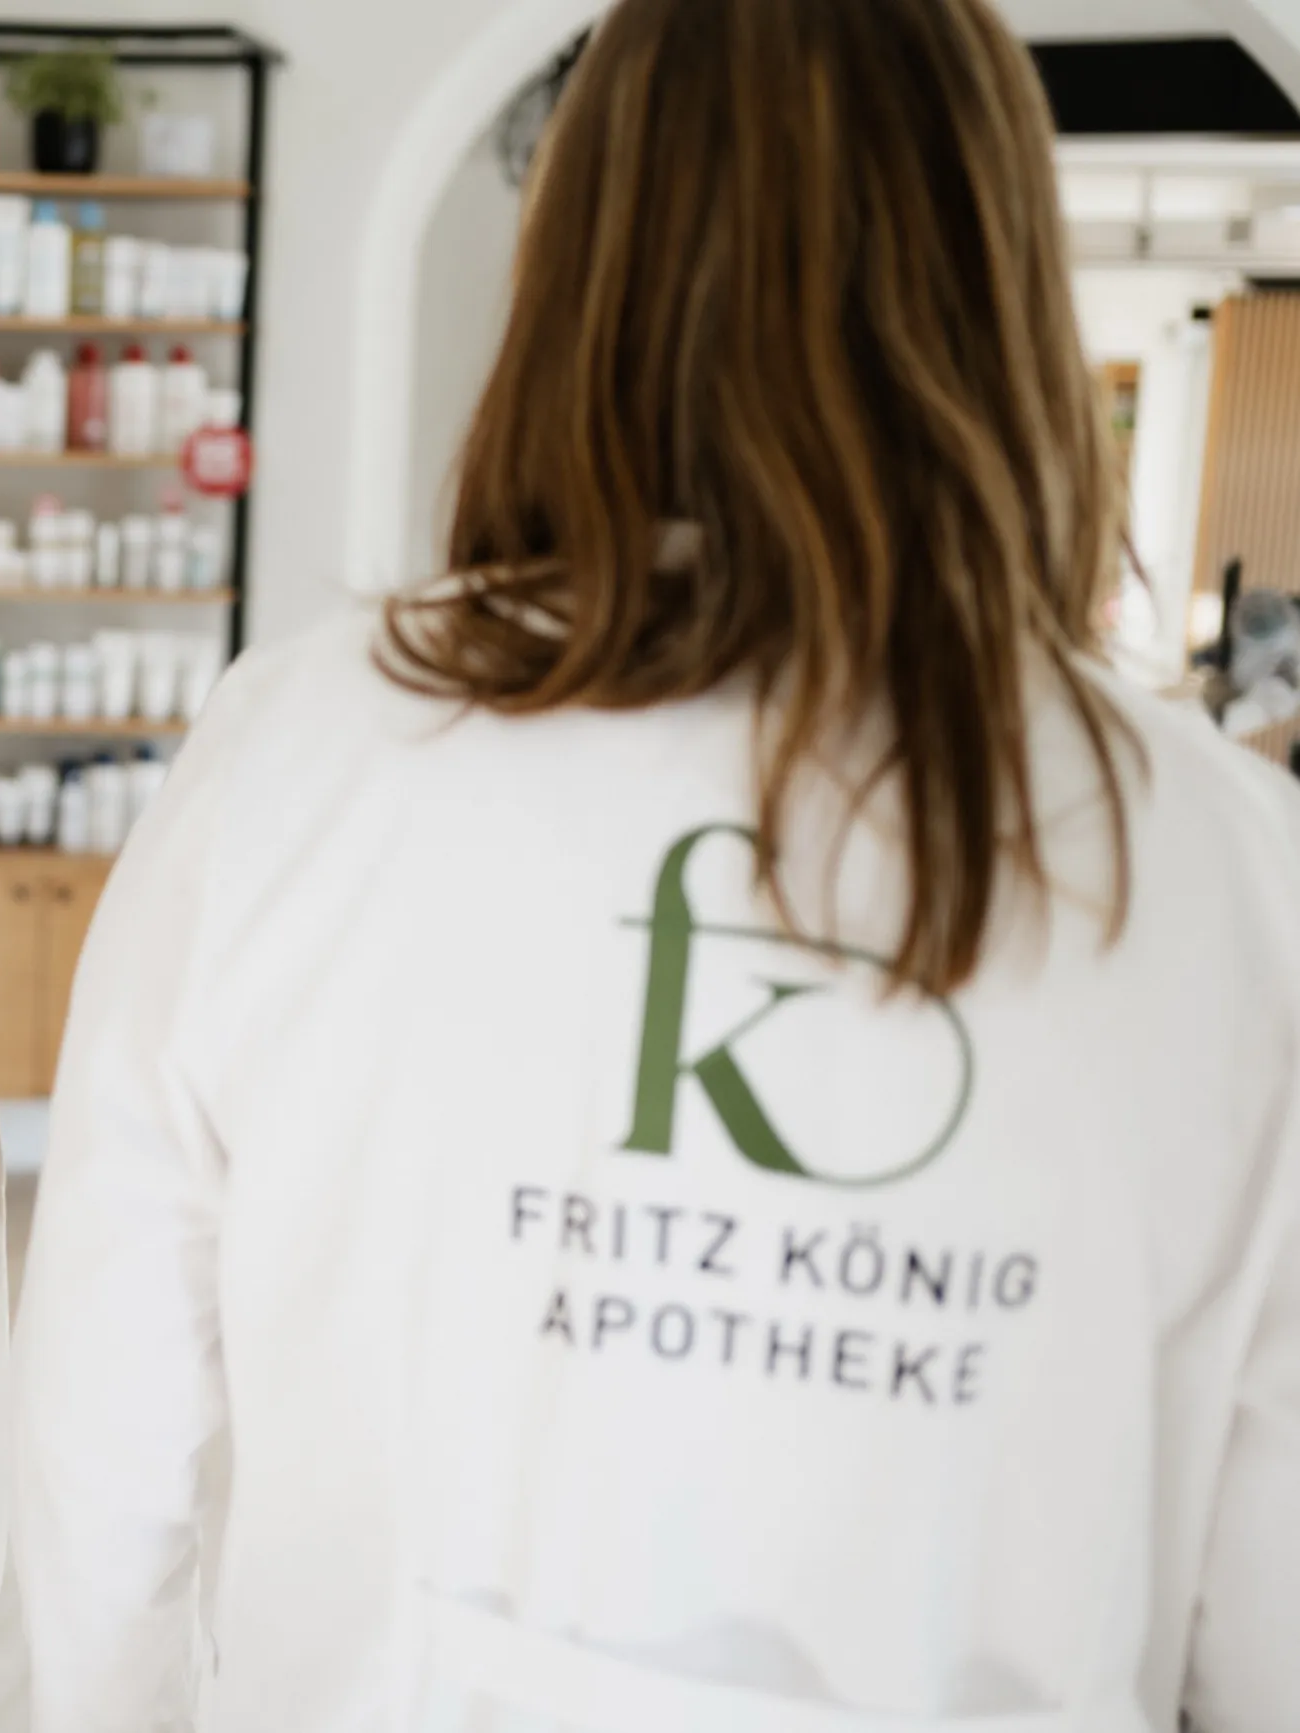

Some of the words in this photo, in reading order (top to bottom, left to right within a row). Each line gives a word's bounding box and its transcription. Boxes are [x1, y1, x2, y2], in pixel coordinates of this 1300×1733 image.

[509, 1185, 739, 1277] FRITZ
[779, 1221, 1039, 1311] KÖNIG
[541, 1290, 988, 1405] APOTHEKE
